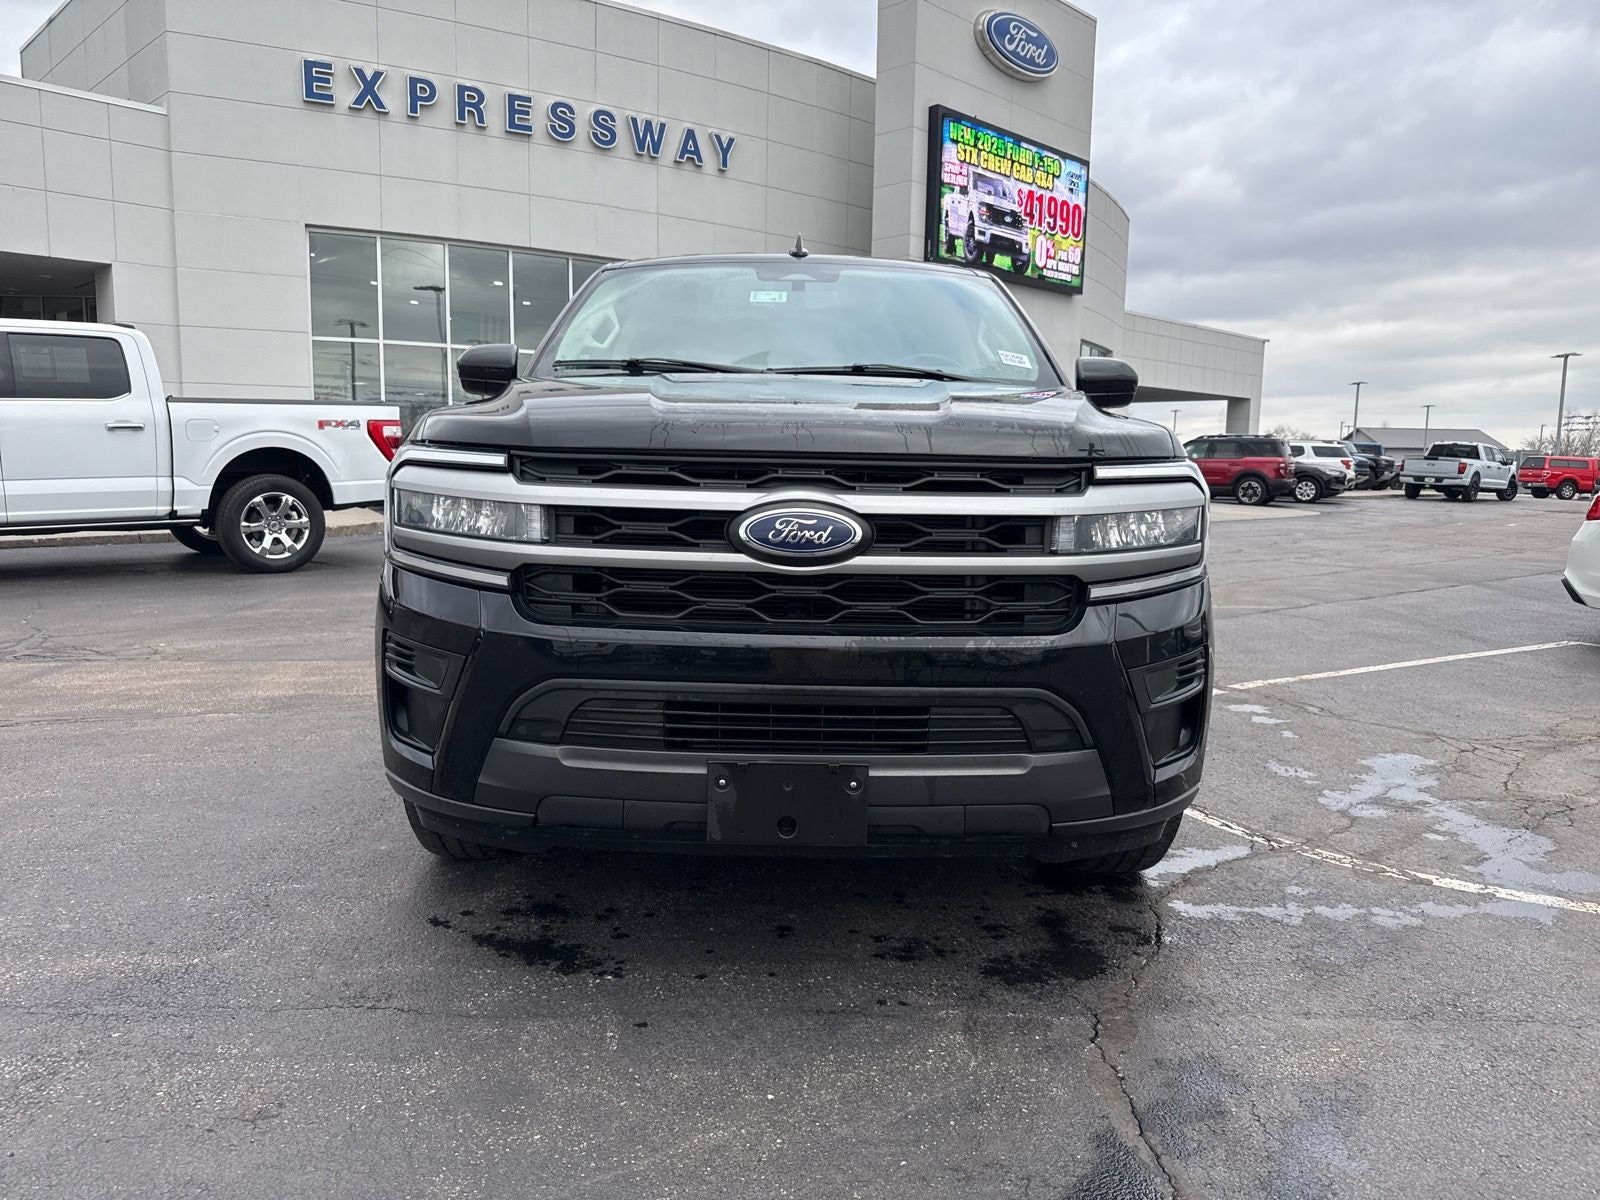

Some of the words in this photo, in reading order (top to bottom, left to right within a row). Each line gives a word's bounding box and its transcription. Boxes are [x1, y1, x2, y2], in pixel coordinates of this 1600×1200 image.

[1004, 21, 1048, 66] Ford
[301, 57, 737, 172] EXPRESSWAY
[949, 121, 976, 147] NEW
[976, 132, 1005, 157] 2025
[1006, 142, 1033, 167] FORD
[1034, 151, 1061, 178] F-150
[957, 142, 979, 166] STX
[980, 151, 1012, 177] CREW
[1012, 162, 1034, 185] CAB
[318, 419, 361, 430] FX4
[768, 517, 834, 545] Ford
